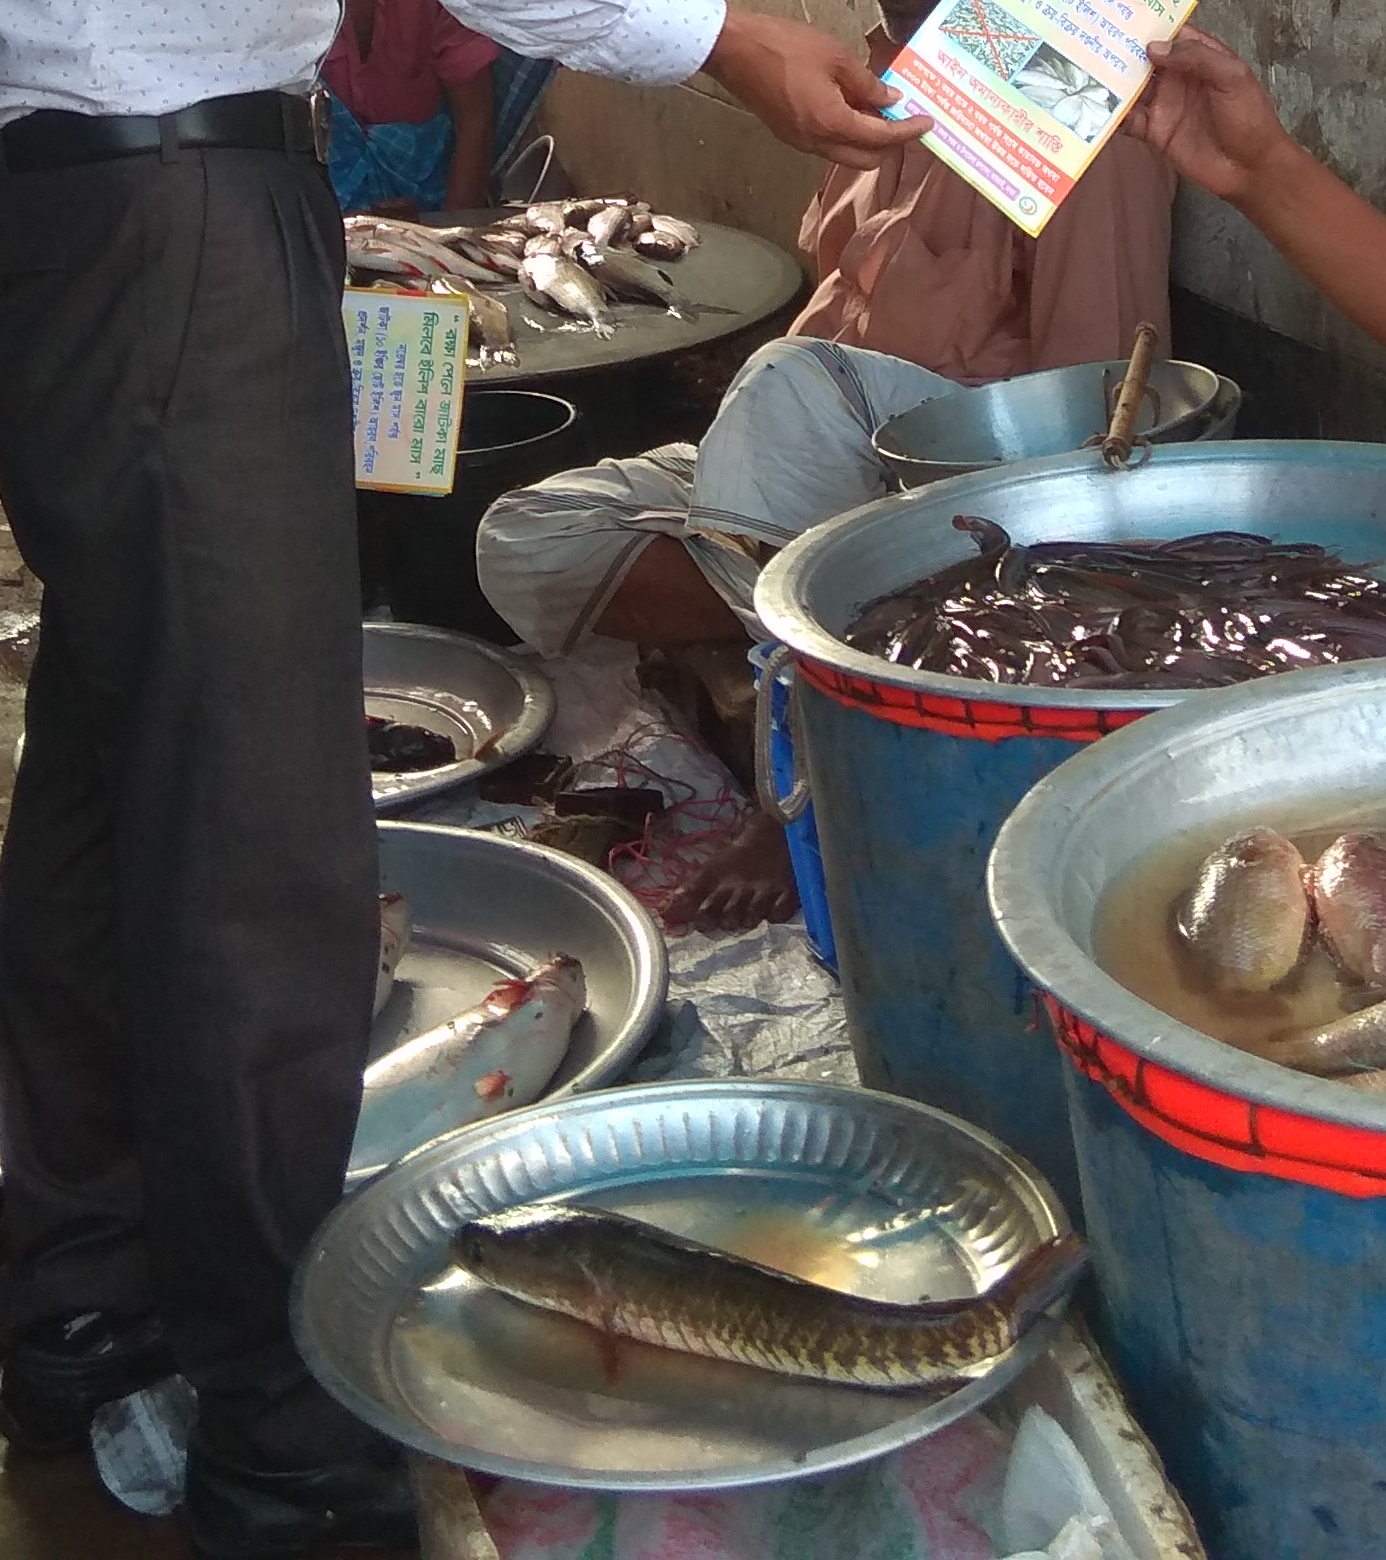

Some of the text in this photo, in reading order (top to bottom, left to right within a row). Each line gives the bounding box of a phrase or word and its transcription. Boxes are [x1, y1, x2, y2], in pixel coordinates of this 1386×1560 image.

[937, 50, 967, 79] আইন
[969, 76, 1035, 133] অমান্যকারীর
[410, 312, 439, 464] মিলবে ইলিশ বারো মাস
[430, 329, 457, 476] রক্ষা পেলে জাটকা মাছ
